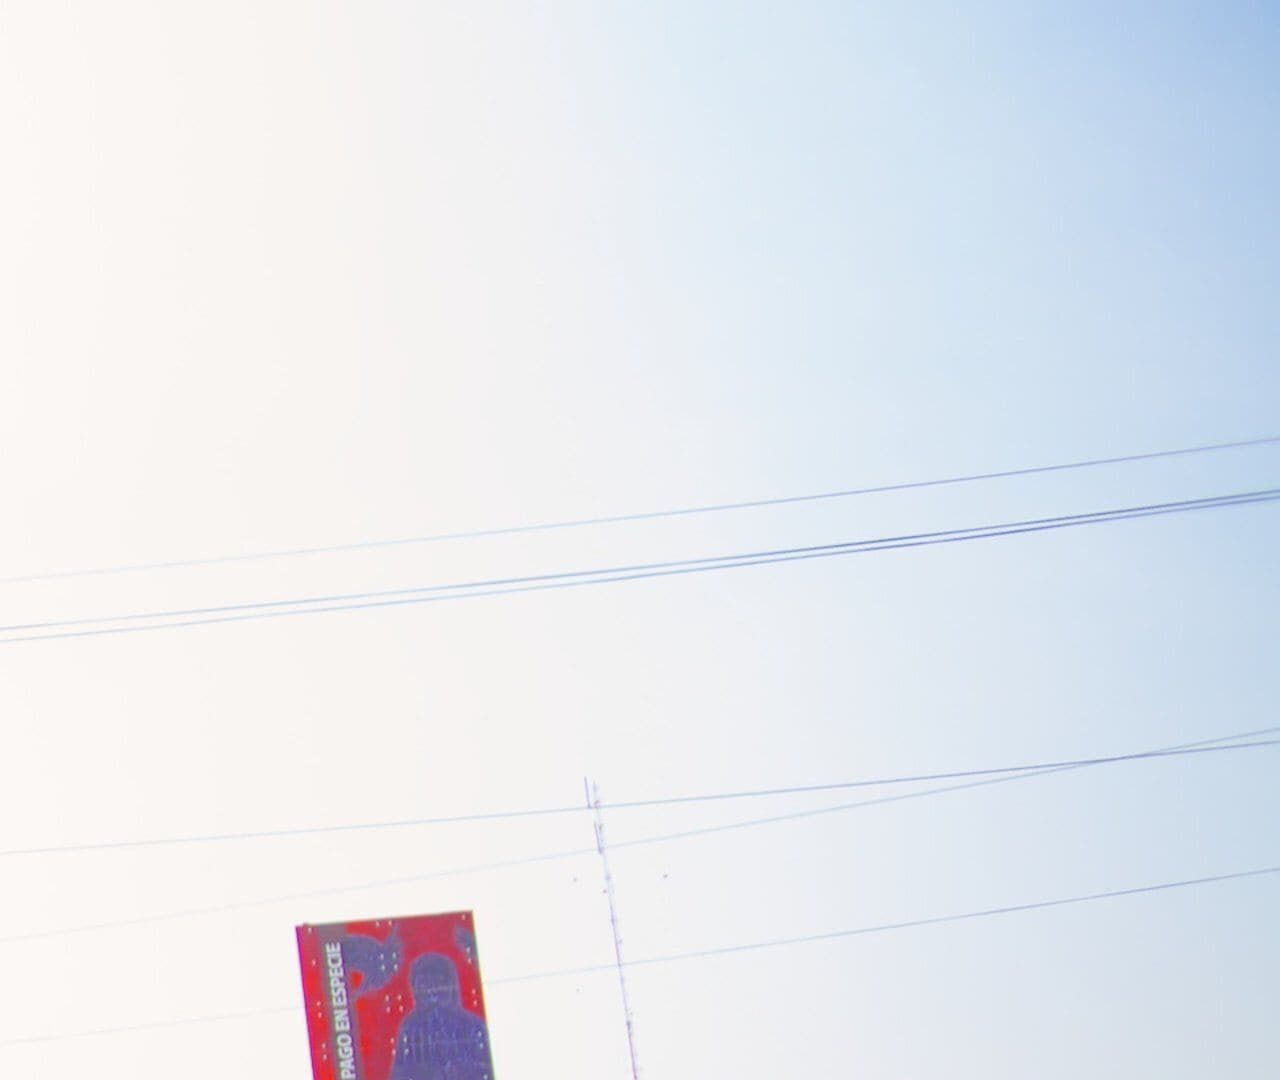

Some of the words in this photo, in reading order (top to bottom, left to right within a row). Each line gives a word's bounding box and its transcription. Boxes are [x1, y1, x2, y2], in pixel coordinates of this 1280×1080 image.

[325, 941, 348, 1002] ESPECIE
[333, 1007, 352, 1032] EN
[337, 1033, 357, 1080] PAGO
